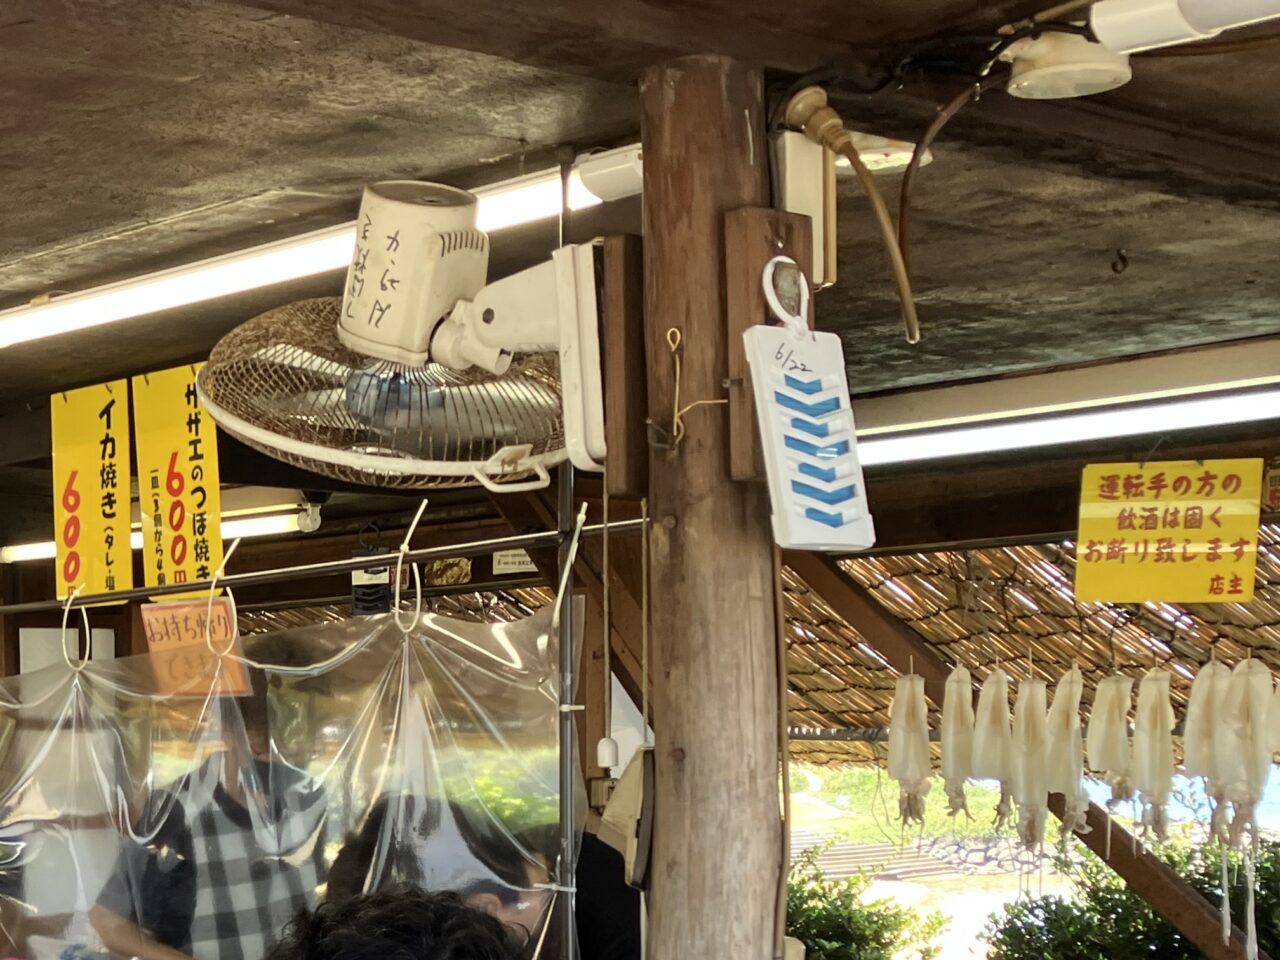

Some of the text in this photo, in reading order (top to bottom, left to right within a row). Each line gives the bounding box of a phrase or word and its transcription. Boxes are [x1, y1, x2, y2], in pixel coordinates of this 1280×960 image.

[773, 342, 814, 373] 6/22
[1098, 471, 1242, 500] 運転手の方の
[1117, 505, 1223, 531] 飲酒は固く
[1083, 537, 1251, 564] お断り致します
[1208, 574, 1244, 596] 店主
